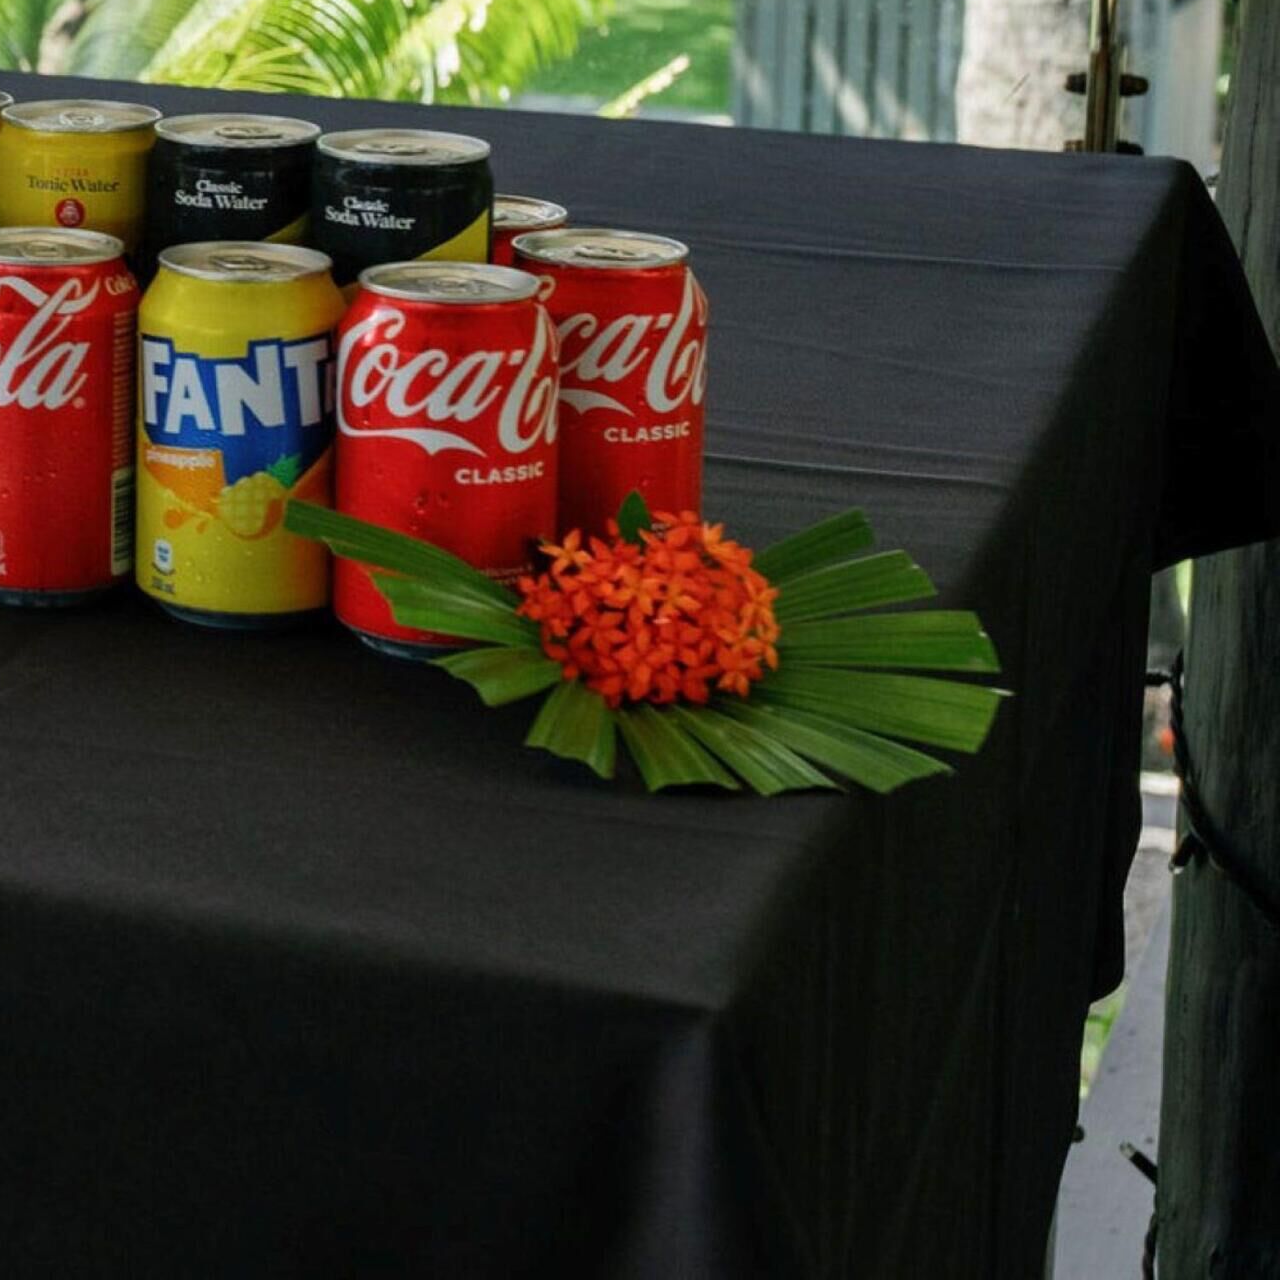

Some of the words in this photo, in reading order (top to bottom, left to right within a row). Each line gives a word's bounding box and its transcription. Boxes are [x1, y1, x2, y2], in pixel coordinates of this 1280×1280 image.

[26, 175, 69, 191] Tonic
[71, 178, 121, 193] Water
[195, 179, 244, 194] Classic
[175, 189, 213, 209] Soda
[216, 194, 269, 211] Water
[343, 195, 389, 212] Classic
[325, 205, 361, 226] Soda
[362, 212, 417, 231] Water
[603, 421, 691, 444] CLASSIC
[454, 461, 546, 486] CLASSIC
